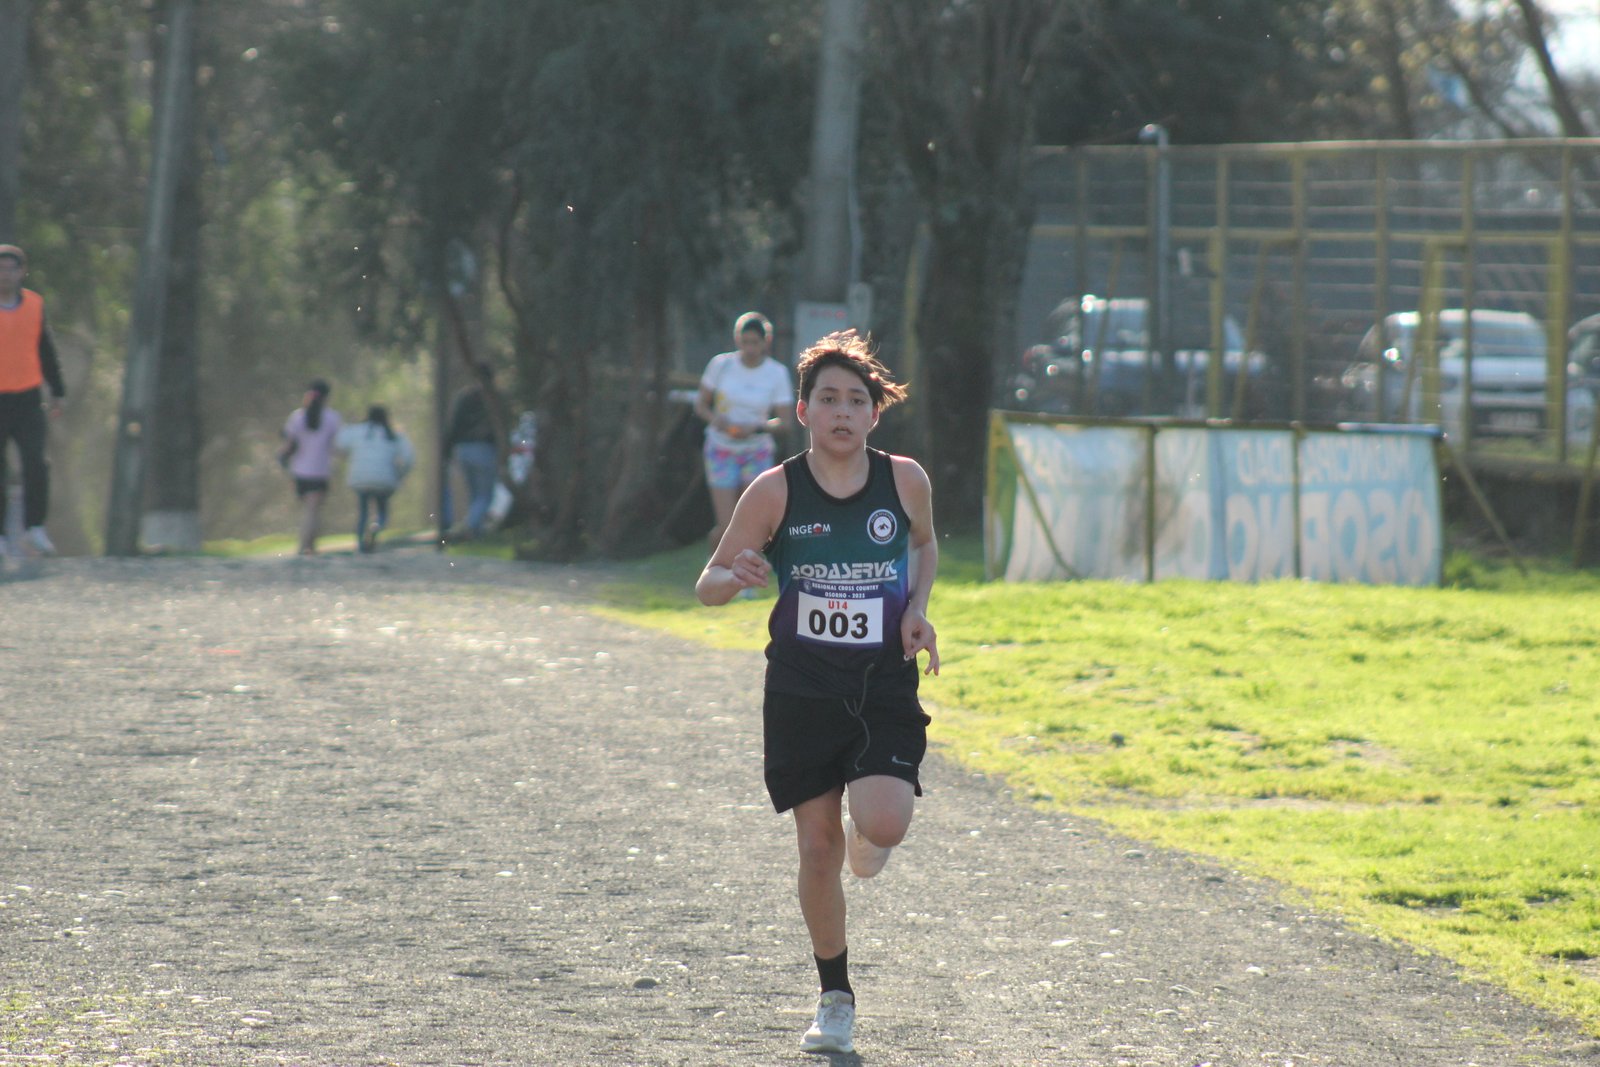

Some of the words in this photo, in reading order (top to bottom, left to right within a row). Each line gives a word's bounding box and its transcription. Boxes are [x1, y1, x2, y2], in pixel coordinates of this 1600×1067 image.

[788, 522, 831, 536] INGEOM
[811, 582, 837, 591] REGIONAL
[856, 584, 879, 592] COUNTRY
[828, 600, 848, 610] U14
[808, 608, 869, 640] 003
